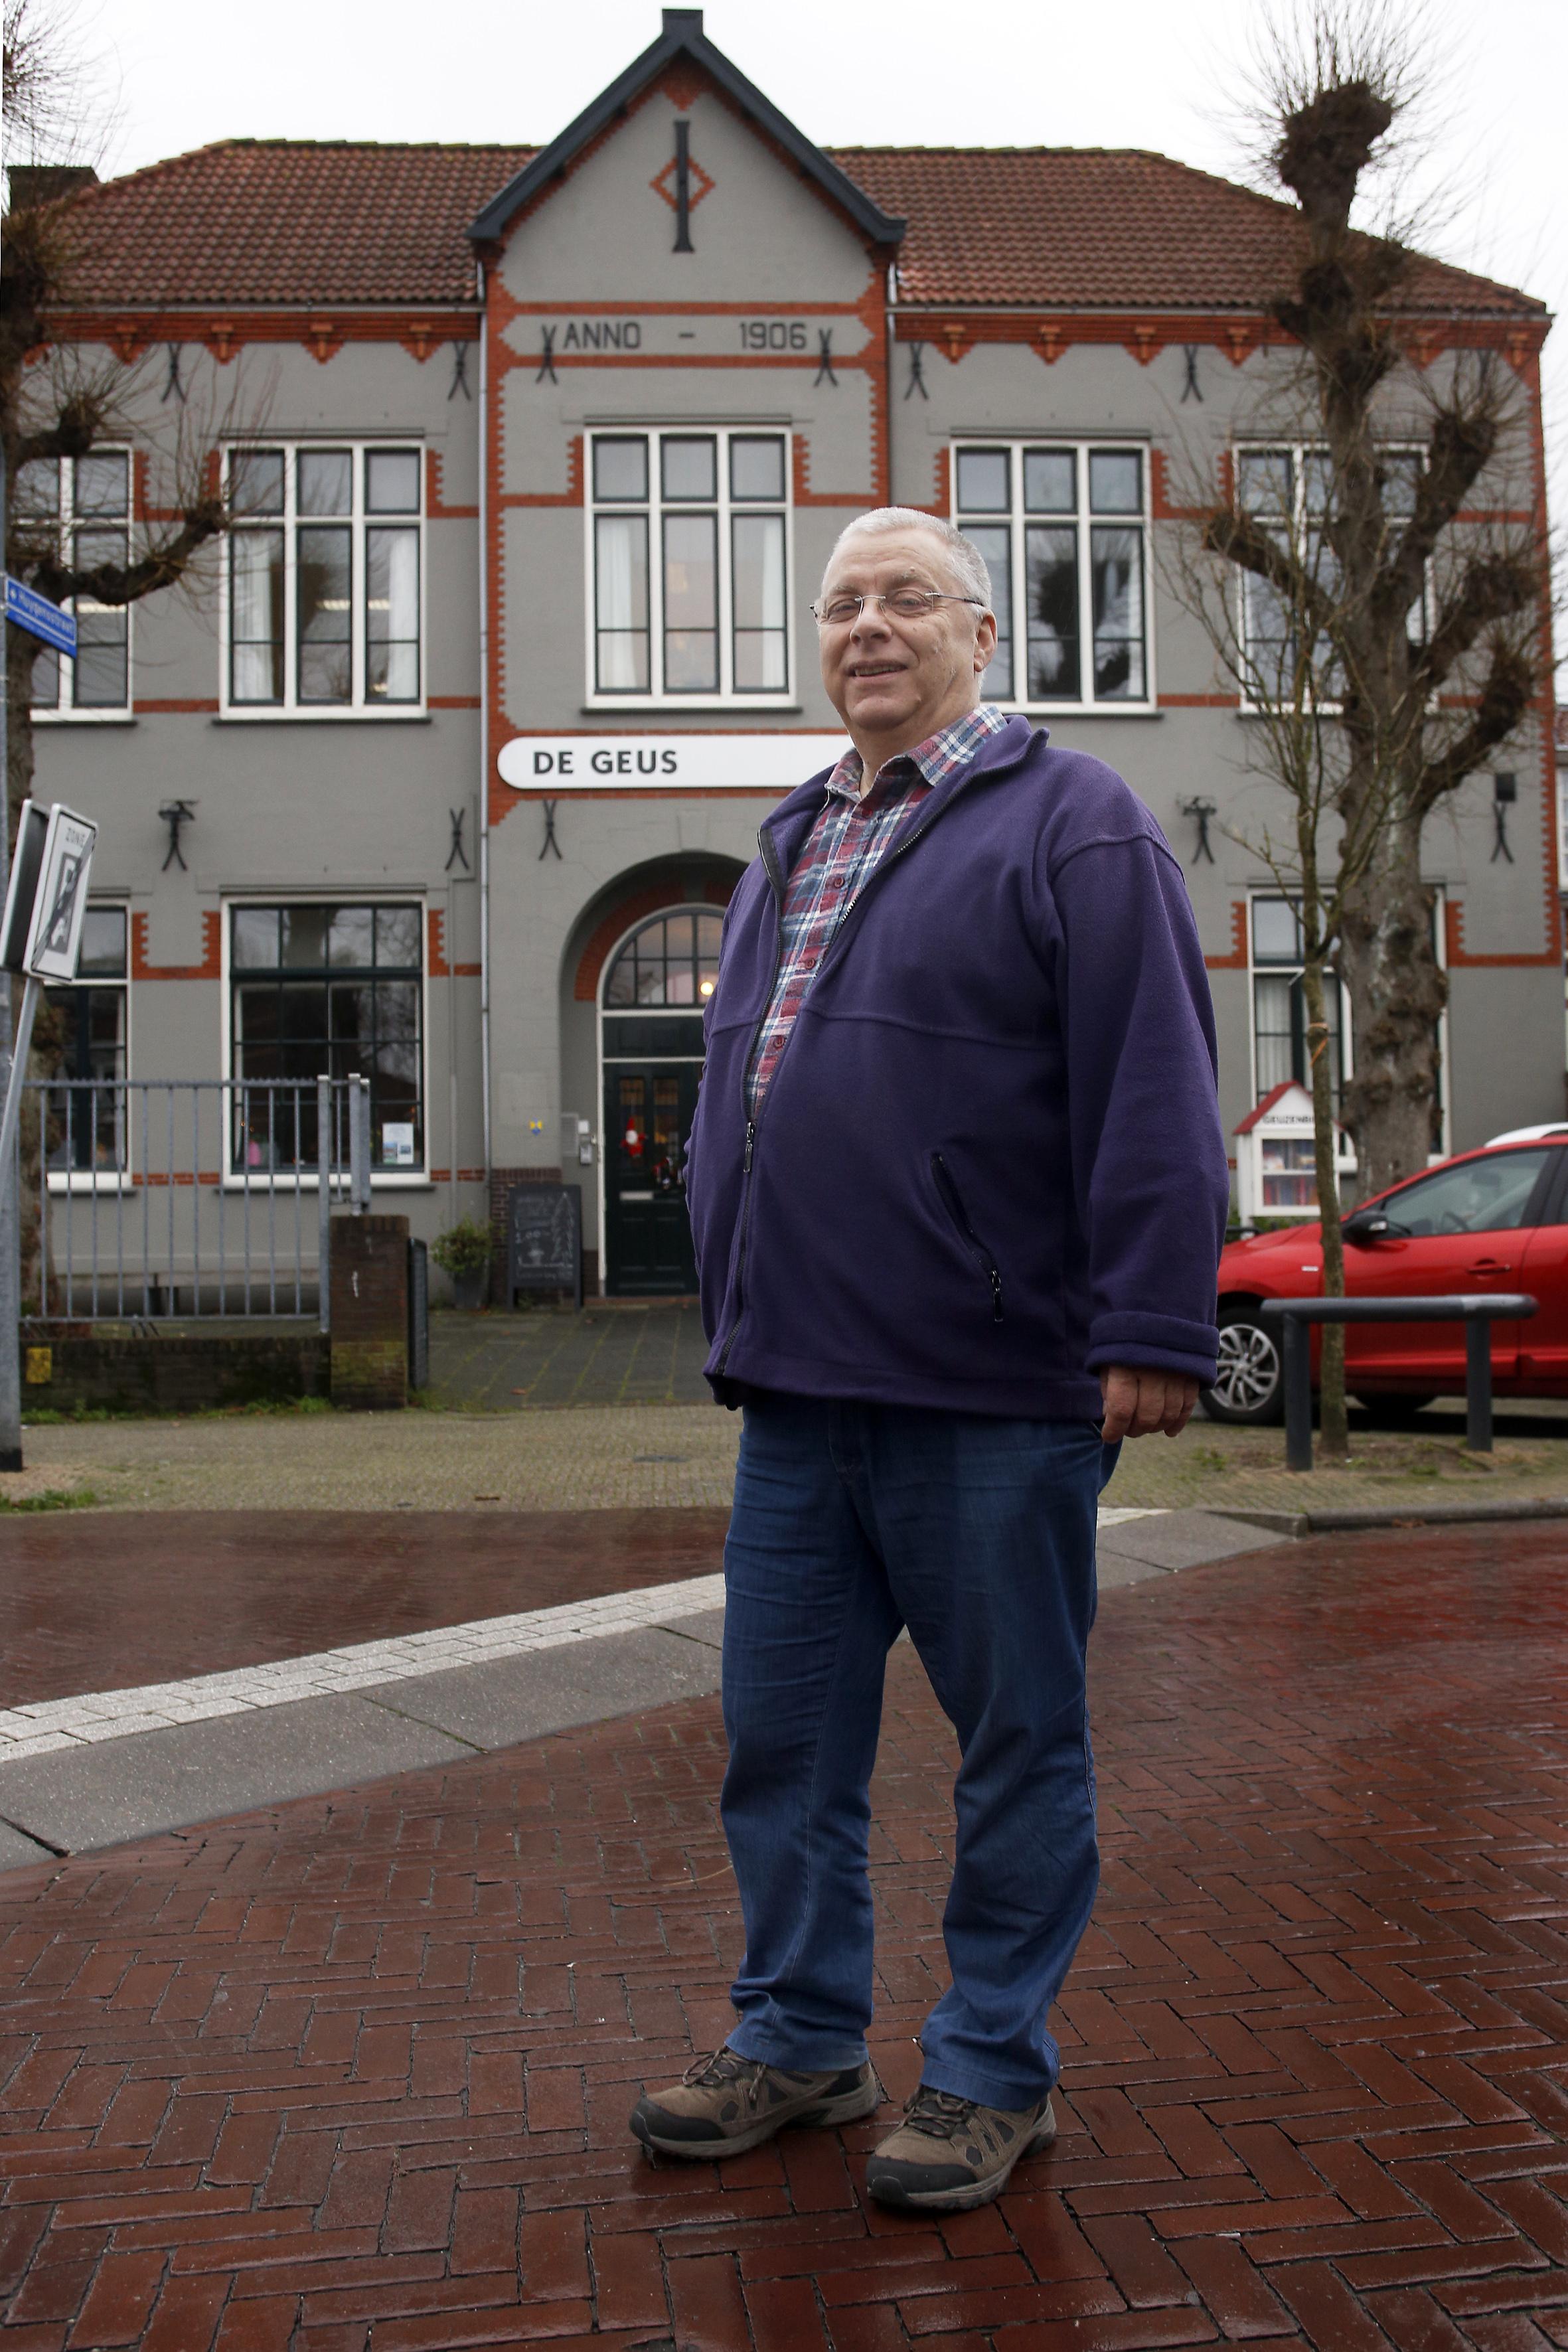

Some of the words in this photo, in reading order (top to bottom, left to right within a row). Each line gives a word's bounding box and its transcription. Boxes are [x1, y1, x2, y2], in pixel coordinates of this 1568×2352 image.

[562, 321, 642, 350] ANNO
[738, 321, 807, 351] 1906
[533, 751, 574, 775] DE
[590, 750, 678, 775] GEUS
[66, 826, 86, 848] ZONE
